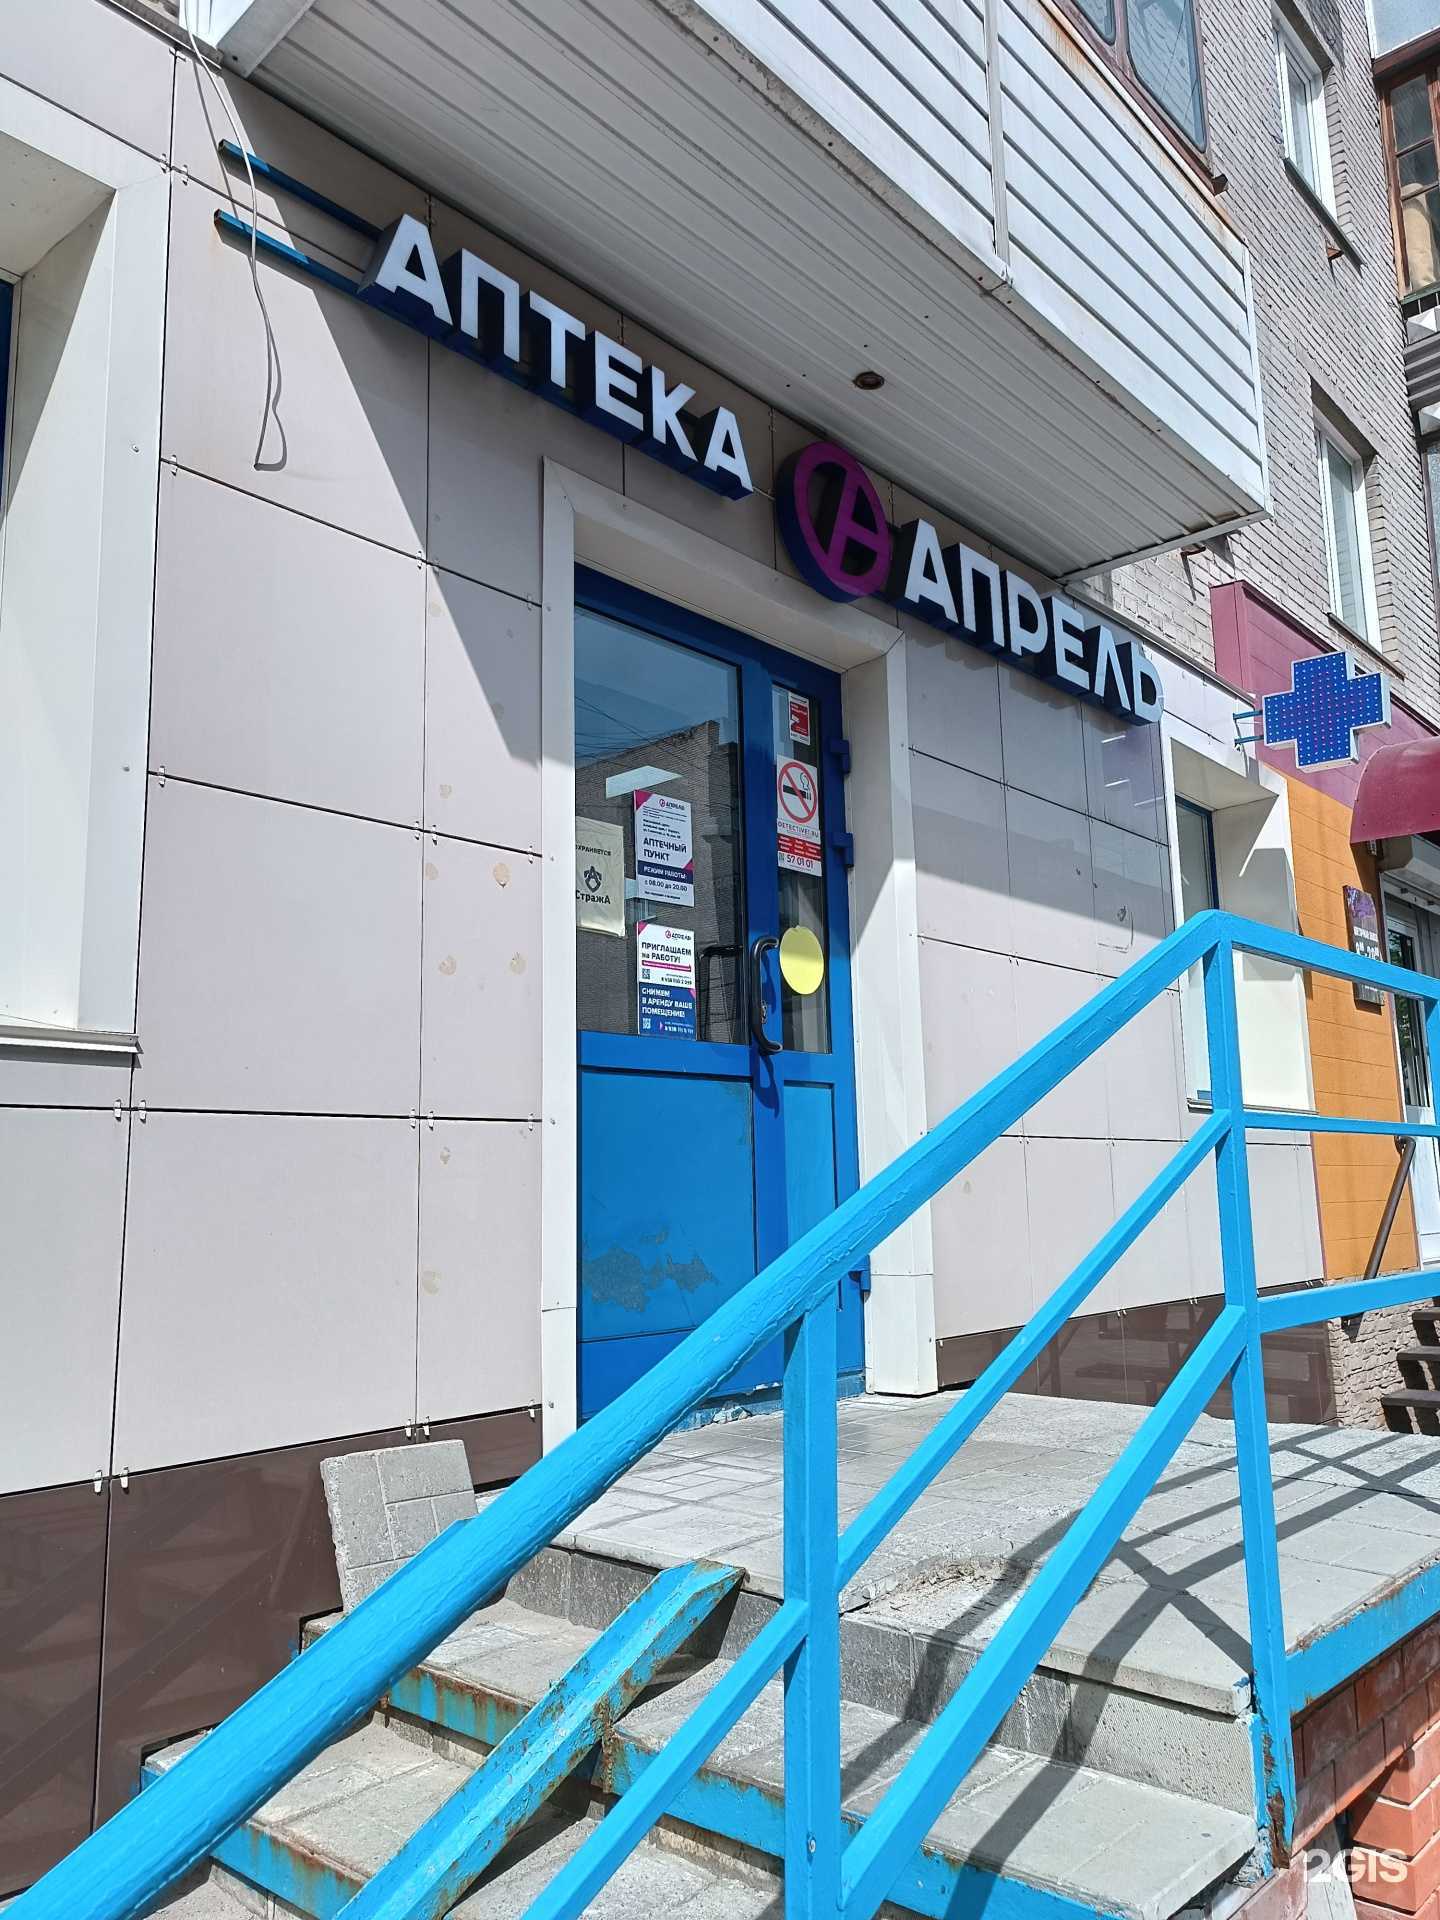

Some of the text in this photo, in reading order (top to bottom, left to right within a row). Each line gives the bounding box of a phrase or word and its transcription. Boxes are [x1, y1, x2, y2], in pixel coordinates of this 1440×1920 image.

[375, 213, 1164, 724] АПТЕКА АПРЕЛЬ
[643, 837, 687, 853] АПТЕЧНЫЙ
[643, 849, 670, 861] ПУНКТ
[786, 855, 795, 863] 57
[797, 857, 805, 866] 01
[805, 859, 814, 869] 01
[575, 889, 611, 904] СтражА
[641, 942, 692, 956] ПРИГЛАШАЕМ
[641, 987, 671, 998] СНИМЕМ
[647, 999, 673, 1007] АРЕНДУ
[674, 1001, 693, 1009] ВАШЕ
